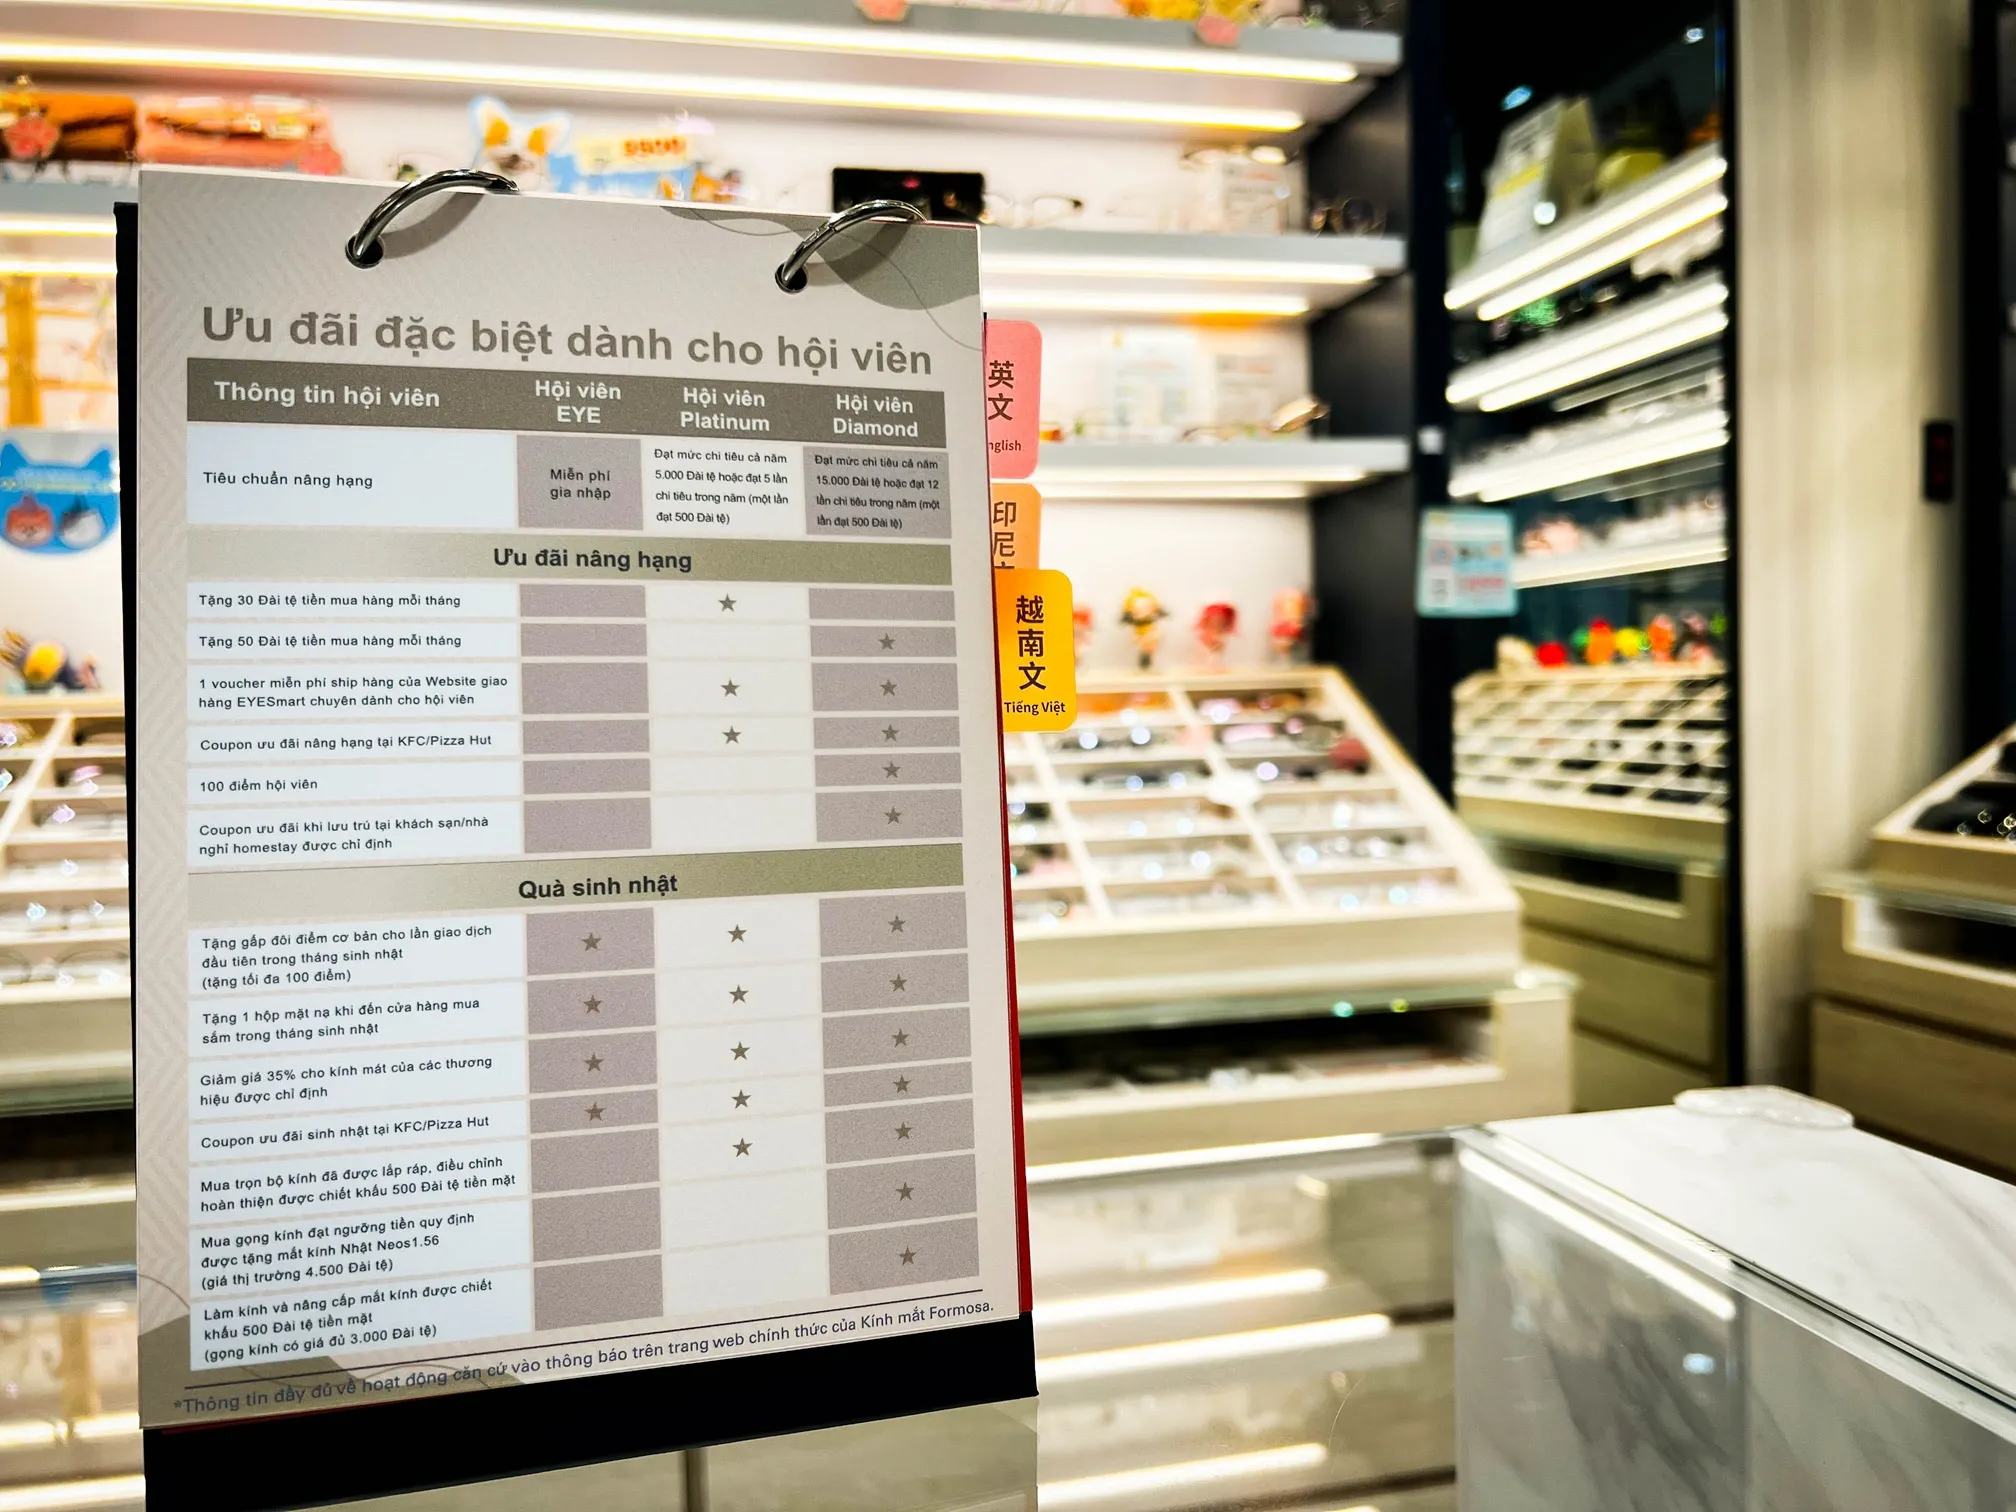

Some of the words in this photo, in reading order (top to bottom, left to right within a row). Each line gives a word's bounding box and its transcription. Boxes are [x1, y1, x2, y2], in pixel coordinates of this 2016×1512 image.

[203, 306, 271, 343] Ưu
[289, 311, 357, 346] đãi
[375, 315, 455, 358] đặc
[472, 319, 553, 362] biệt
[567, 324, 672, 360] dành
[687, 331, 763, 365] cho
[777, 335, 837, 377] hội
[850, 341, 931, 375] viên
[213, 380, 295, 407] Thông
[303, 384, 334, 404] tin
[344, 385, 381, 409] hội
[389, 387, 439, 407] viên
[535, 379, 570, 401] Hội
[576, 381, 621, 400] viên
[683, 386, 717, 408] Hội
[722, 389, 765, 407] viên
[987, 360, 1015, 421] 英文
[557, 405, 601, 423] EYE
[836, 393, 868, 415] Hội
[873, 396, 913, 413] viên
[680, 411, 770, 431] Platinum
[833, 417, 918, 437] Diamond
[988, 440, 1022, 453] nglish
[202, 471, 236, 484] Tiêu
[241, 470, 288, 485] chuẩn
[294, 474, 330, 489] nâng
[336, 474, 372, 489] hạng
[550, 467, 583, 481] Miễn
[588, 470, 610, 484] phí
[550, 486, 571, 500] gia
[576, 487, 611, 501] nhập
[493, 547, 527, 566] Ưu
[534, 548, 568, 567] đãi
[576, 549, 630, 572] nâng
[638, 550, 691, 573] hạng
[198, 594, 232, 608] Tặng
[237, 595, 253, 605] 30
[258, 594, 280, 605] Đài
[285, 595, 297, 607] tệ
[301, 592, 326, 605] tiền
[330, 597, 357, 605] mua
[362, 595, 394, 608] hàng
[398, 593, 421, 605] mỗi
[425, 595, 460, 608] tháng
[1016, 595, 1047, 691] 越南文
[199, 678, 205, 689] 1
[211, 678, 265, 689] voucher
[270, 676, 301, 688] miễn
[306, 677, 326, 690] phí
[331, 677, 358, 689] ship
[362, 676, 393, 689] hàng
[398, 675, 421, 687] của
[425, 676, 476, 686] Website
[481, 675, 507, 688] giao
[199, 697, 232, 710] hàng
[237, 696, 305, 707] EYESmart
[310, 695, 356, 709] chuyên
[361, 695, 392, 706] dành
[397, 694, 420, 705] cho
[424, 694, 444, 706] hội
[448, 694, 474, 704] viên
[1004, 700, 1039, 716] Tiếng
[1041, 700, 1066, 716] Việt
[200, 739, 252, 752] Coupon
[257, 741, 275, 749] ưu
[279, 738, 299, 749] đãi
[304, 737, 336, 750] nâng
[341, 737, 373, 750] hạng
[377, 736, 393, 749] tại
[397, 735, 465, 746] KFC/Pizza
[469, 735, 491, 745] Hut
[200, 780, 224, 792] 100
[228, 778, 261, 791] điểm
[266, 779, 286, 792] hội
[290, 778, 317, 789] viên
[199, 824, 251, 837] Coupon
[256, 825, 274, 834] ưu
[279, 822, 298, 833] đãi
[303, 821, 322, 832] khi
[327, 821, 348, 831] lưu
[353, 820, 370, 831] trú
[375, 819, 390, 831] tại
[395, 818, 433, 829] khách
[438, 816, 488, 829] sạn/nhà
[199, 843, 228, 857] nghỉ
[233, 842, 297, 854] homestay
[302, 840, 337, 852] được
[341, 838, 360, 850] chỉ
[365, 838, 392, 850] định
[518, 878, 565, 899] Quà
[572, 876, 621, 896] sinh
[628, 874, 678, 896] nhật
[201, 938, 236, 951] Tặng
[241, 934, 266, 950] gấp
[271, 934, 291, 946] đôi
[295, 931, 327, 945] điểm
[332, 934, 349, 943] cơ
[353, 930, 377, 942] bản
[382, 929, 405, 940] cho
[410, 926, 429, 939] lần
[433, 927, 461, 940] giao
[465, 925, 491, 938] dịch
[200, 1073, 236, 1086] Giảm
[241, 1071, 261, 1086] giá
[267, 1069, 296, 1081] 35%
[301, 1068, 325, 1079] cho
[329, 1065, 357, 1077] kính
[362, 1063, 386, 1075] mát
[391, 1061, 414, 1073] của
[418, 1059, 441, 1071] các
[445, 1058, 492, 1069] thương
[200, 1093, 229, 1107] hiệu
[234, 1092, 270, 1104] được
[275, 1087, 294, 1100] chỉ
[299, 1086, 327, 1100] định
[204, 1348, 244, 1363] (gọng
[248, 1342, 278, 1356] kính
[283, 1339, 299, 1352] có
[303, 1337, 324, 1352] giá
[328, 1334, 345, 1347] đủ
[350, 1329, 387, 1344] 3.000
[391, 1326, 414, 1340] Đài
[419, 1324, 437, 1338] tệ)
[246, 1392, 267, 1406] tin
[274, 1384, 305, 1403] đầy
[311, 1383, 332, 1397] đủ
[337, 1379, 356, 1395] về
[362, 1376, 400, 1393] hoạt
[406, 1372, 448, 1388] động
[453, 1365, 481, 1382] căn
[487, 1361, 508, 1377] cứ
[512, 1357, 540, 1373] vào
[545, 1353, 592, 1369] thông
[598, 1347, 627, 1363] báo
[632, 1343, 663, 1359] trên
[668, 1340, 708, 1354] trang
[712, 1332, 744, 1348] web
[748, 1326, 789, 1344] chính
[794, 1322, 827, 1338] thức
[831, 1318, 856, 1333] của
[861, 1312, 893, 1329] Kính
[898, 1305, 925, 1324] mắt
[929, 1302, 993, 1319] Formosa.
